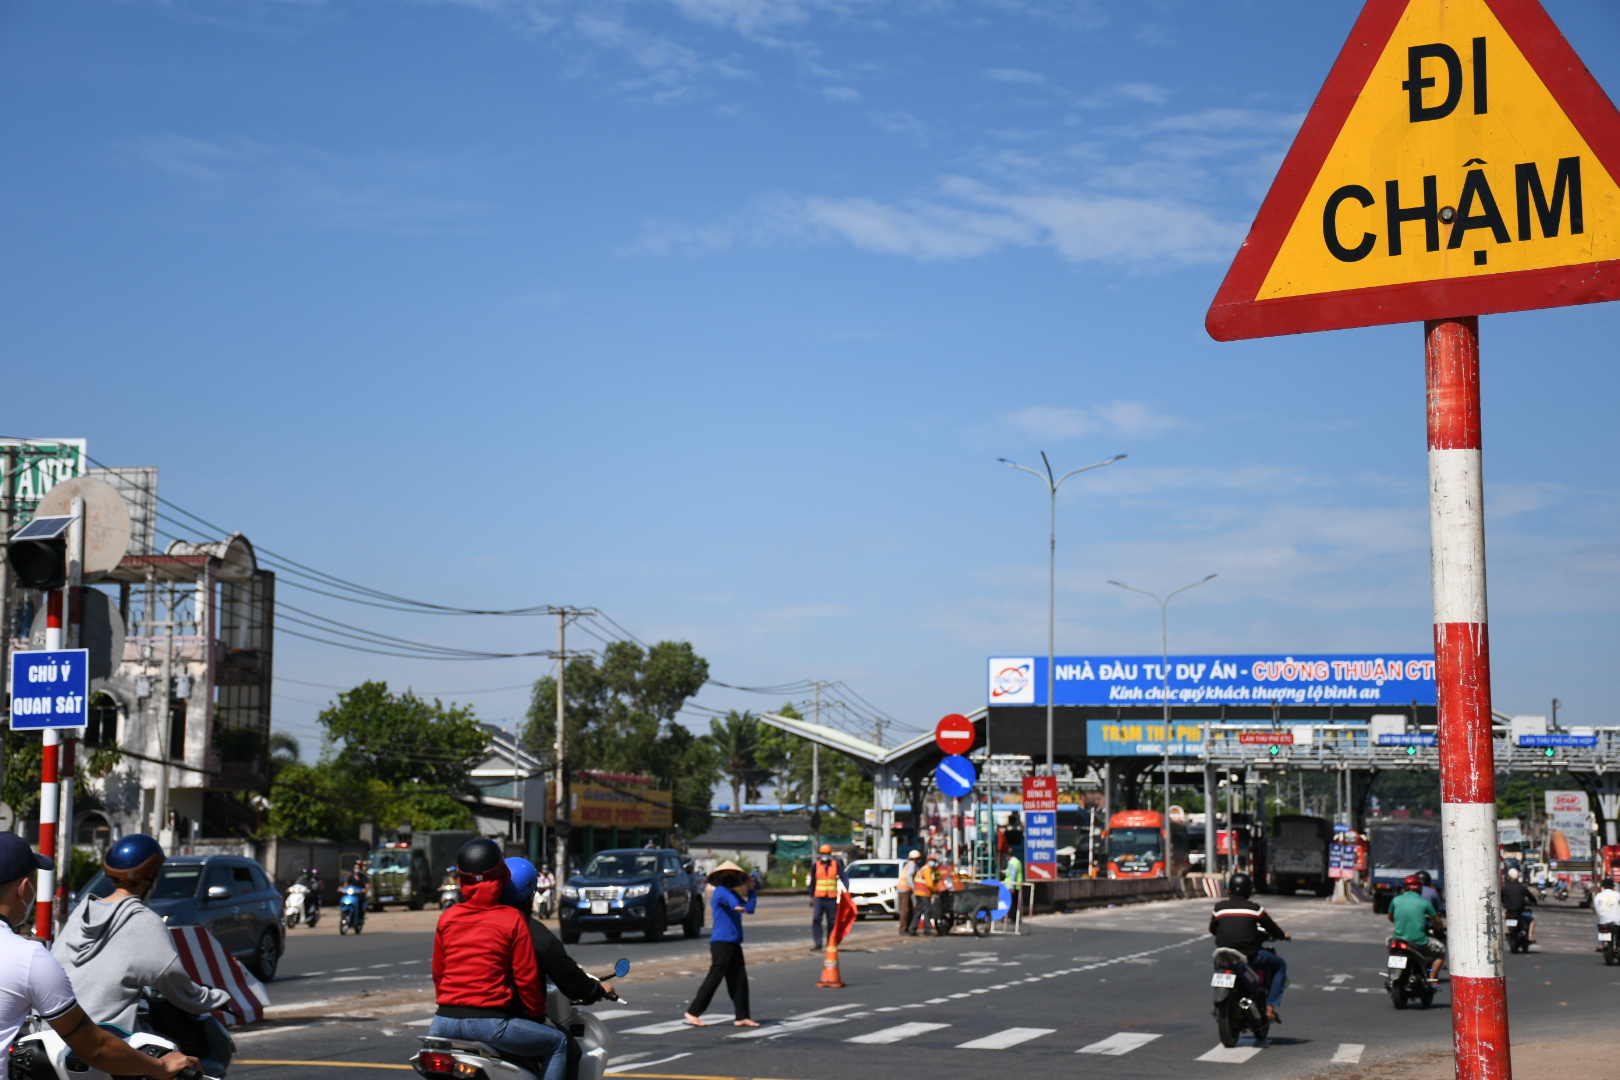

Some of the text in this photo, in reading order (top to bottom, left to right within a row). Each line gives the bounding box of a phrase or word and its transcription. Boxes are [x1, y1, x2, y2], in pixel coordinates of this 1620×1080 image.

[1402, 36, 1488, 123] ĐI
[1322, 156, 1584, 266] CHẬM
[28, 659, 72, 683] CHÚ Ý
[1055, 659, 1095, 681] NHÀ
[1142, 663, 1172, 681] TƯ
[1175, 663, 1207, 684] DỰ
[1209, 659, 1237, 680] ÁN
[1251, 656, 1330, 681] CƯỜNG
[1331, 658, 1404, 687] THUẬN
[13, 690, 83, 717] QUAN SÁT
[1109, 685, 1381, 703] Kính chúc quý khách thượng lộ bình an
[1101, 725, 1143, 744] TRẠM
[1145, 725, 1175, 742] THU
